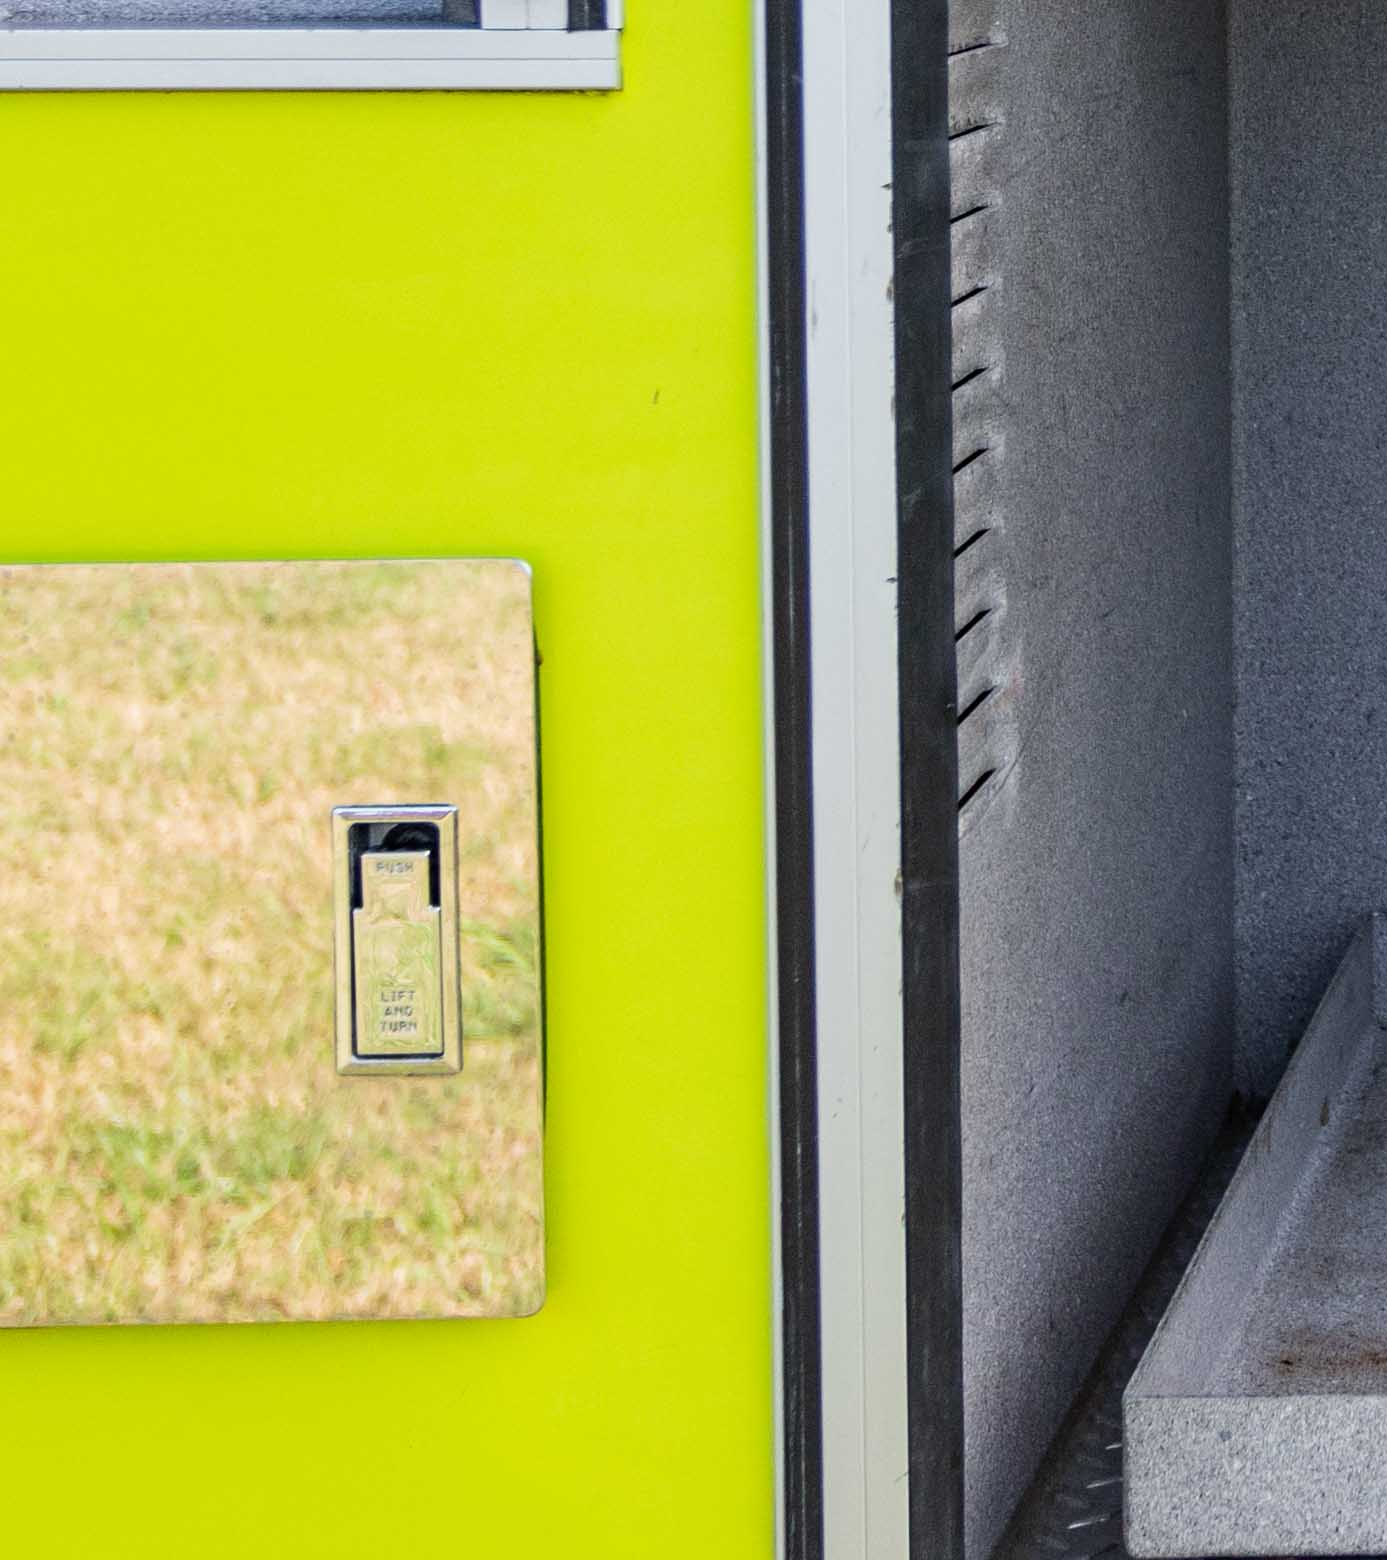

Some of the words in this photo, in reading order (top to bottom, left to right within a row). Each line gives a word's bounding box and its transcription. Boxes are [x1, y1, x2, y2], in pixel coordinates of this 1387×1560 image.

[375, 862, 414, 873] PUSH
[380, 990, 416, 1002] LIFT
[384, 1005, 413, 1017] AND
[380, 1021, 417, 1033] TURN
